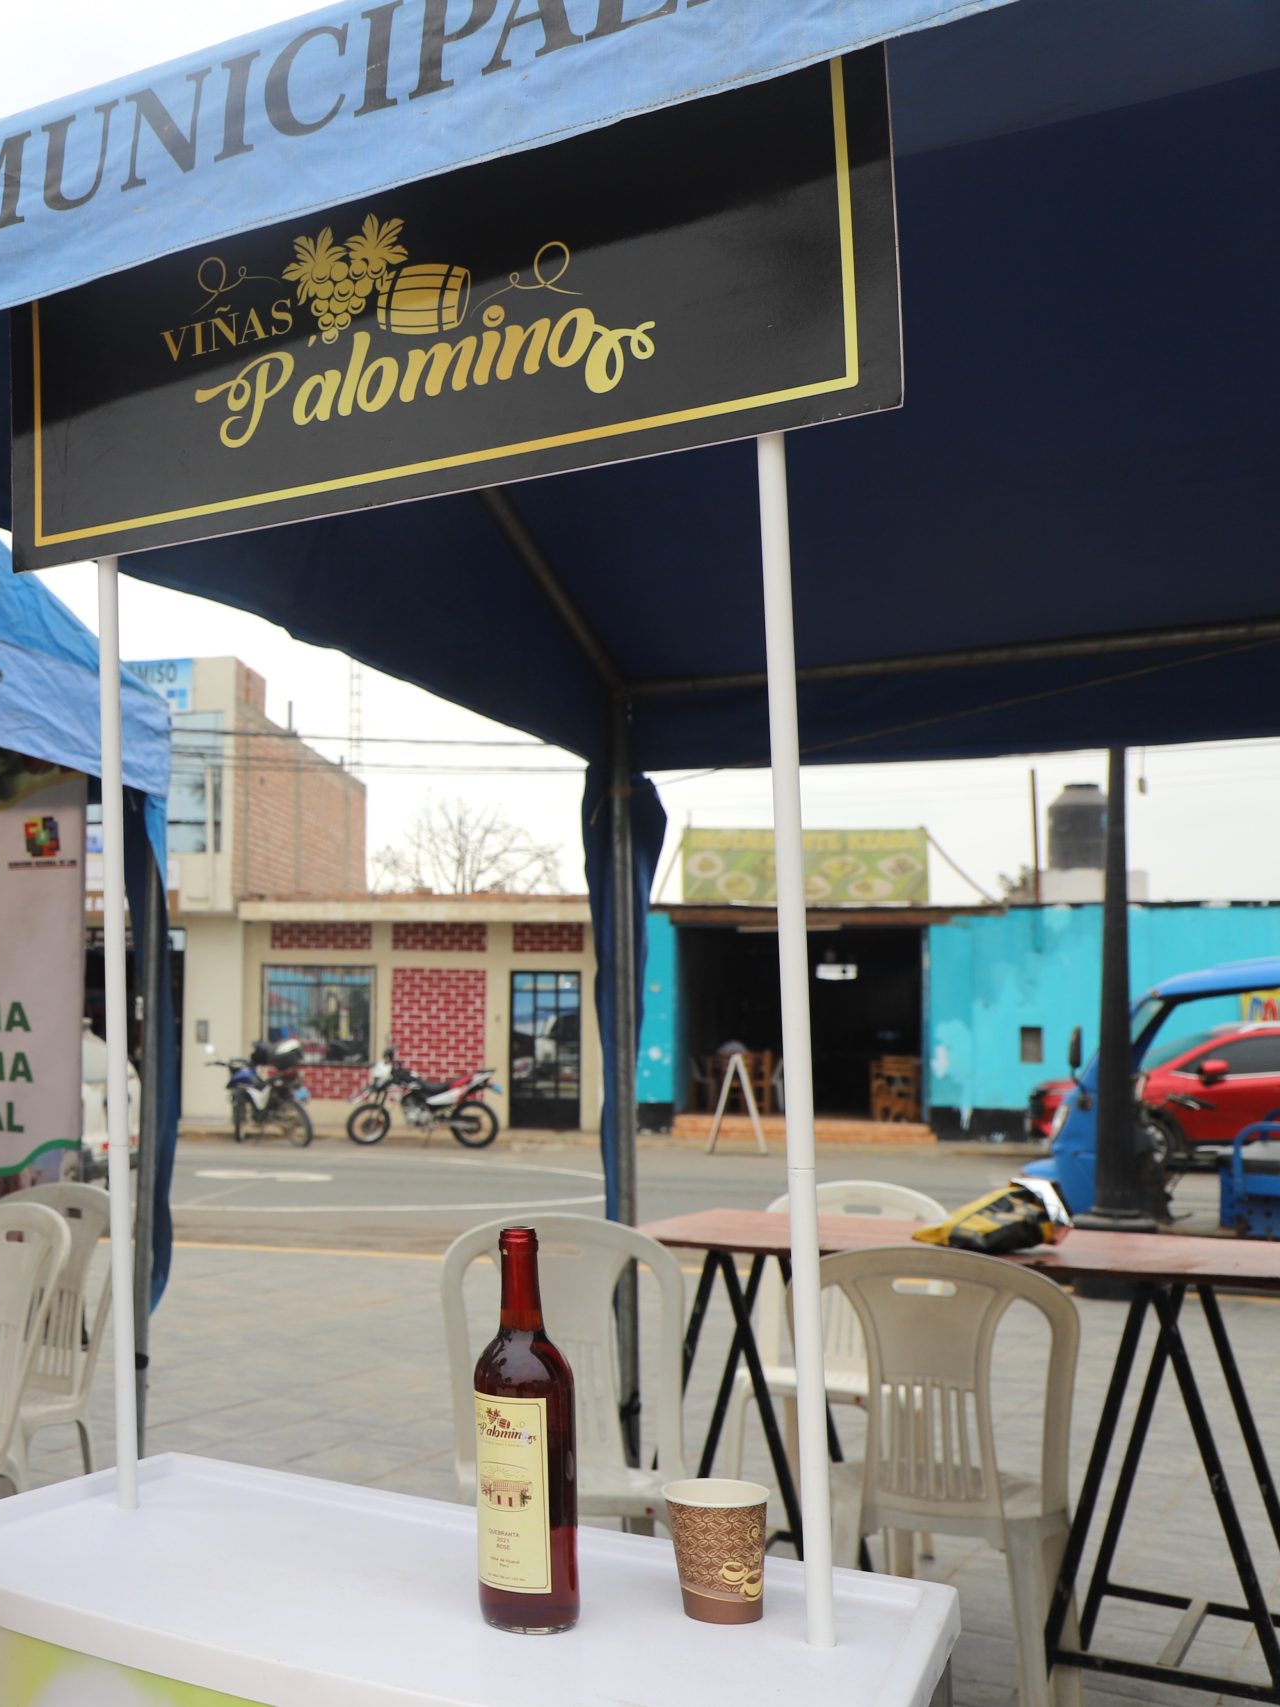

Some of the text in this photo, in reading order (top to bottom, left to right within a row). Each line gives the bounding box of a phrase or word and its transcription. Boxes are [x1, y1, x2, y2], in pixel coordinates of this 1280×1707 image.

[159, 298, 294, 362] VIÑAS
[195, 305, 656, 449] Palomino
[477, 1421, 537, 1444] Palomin
